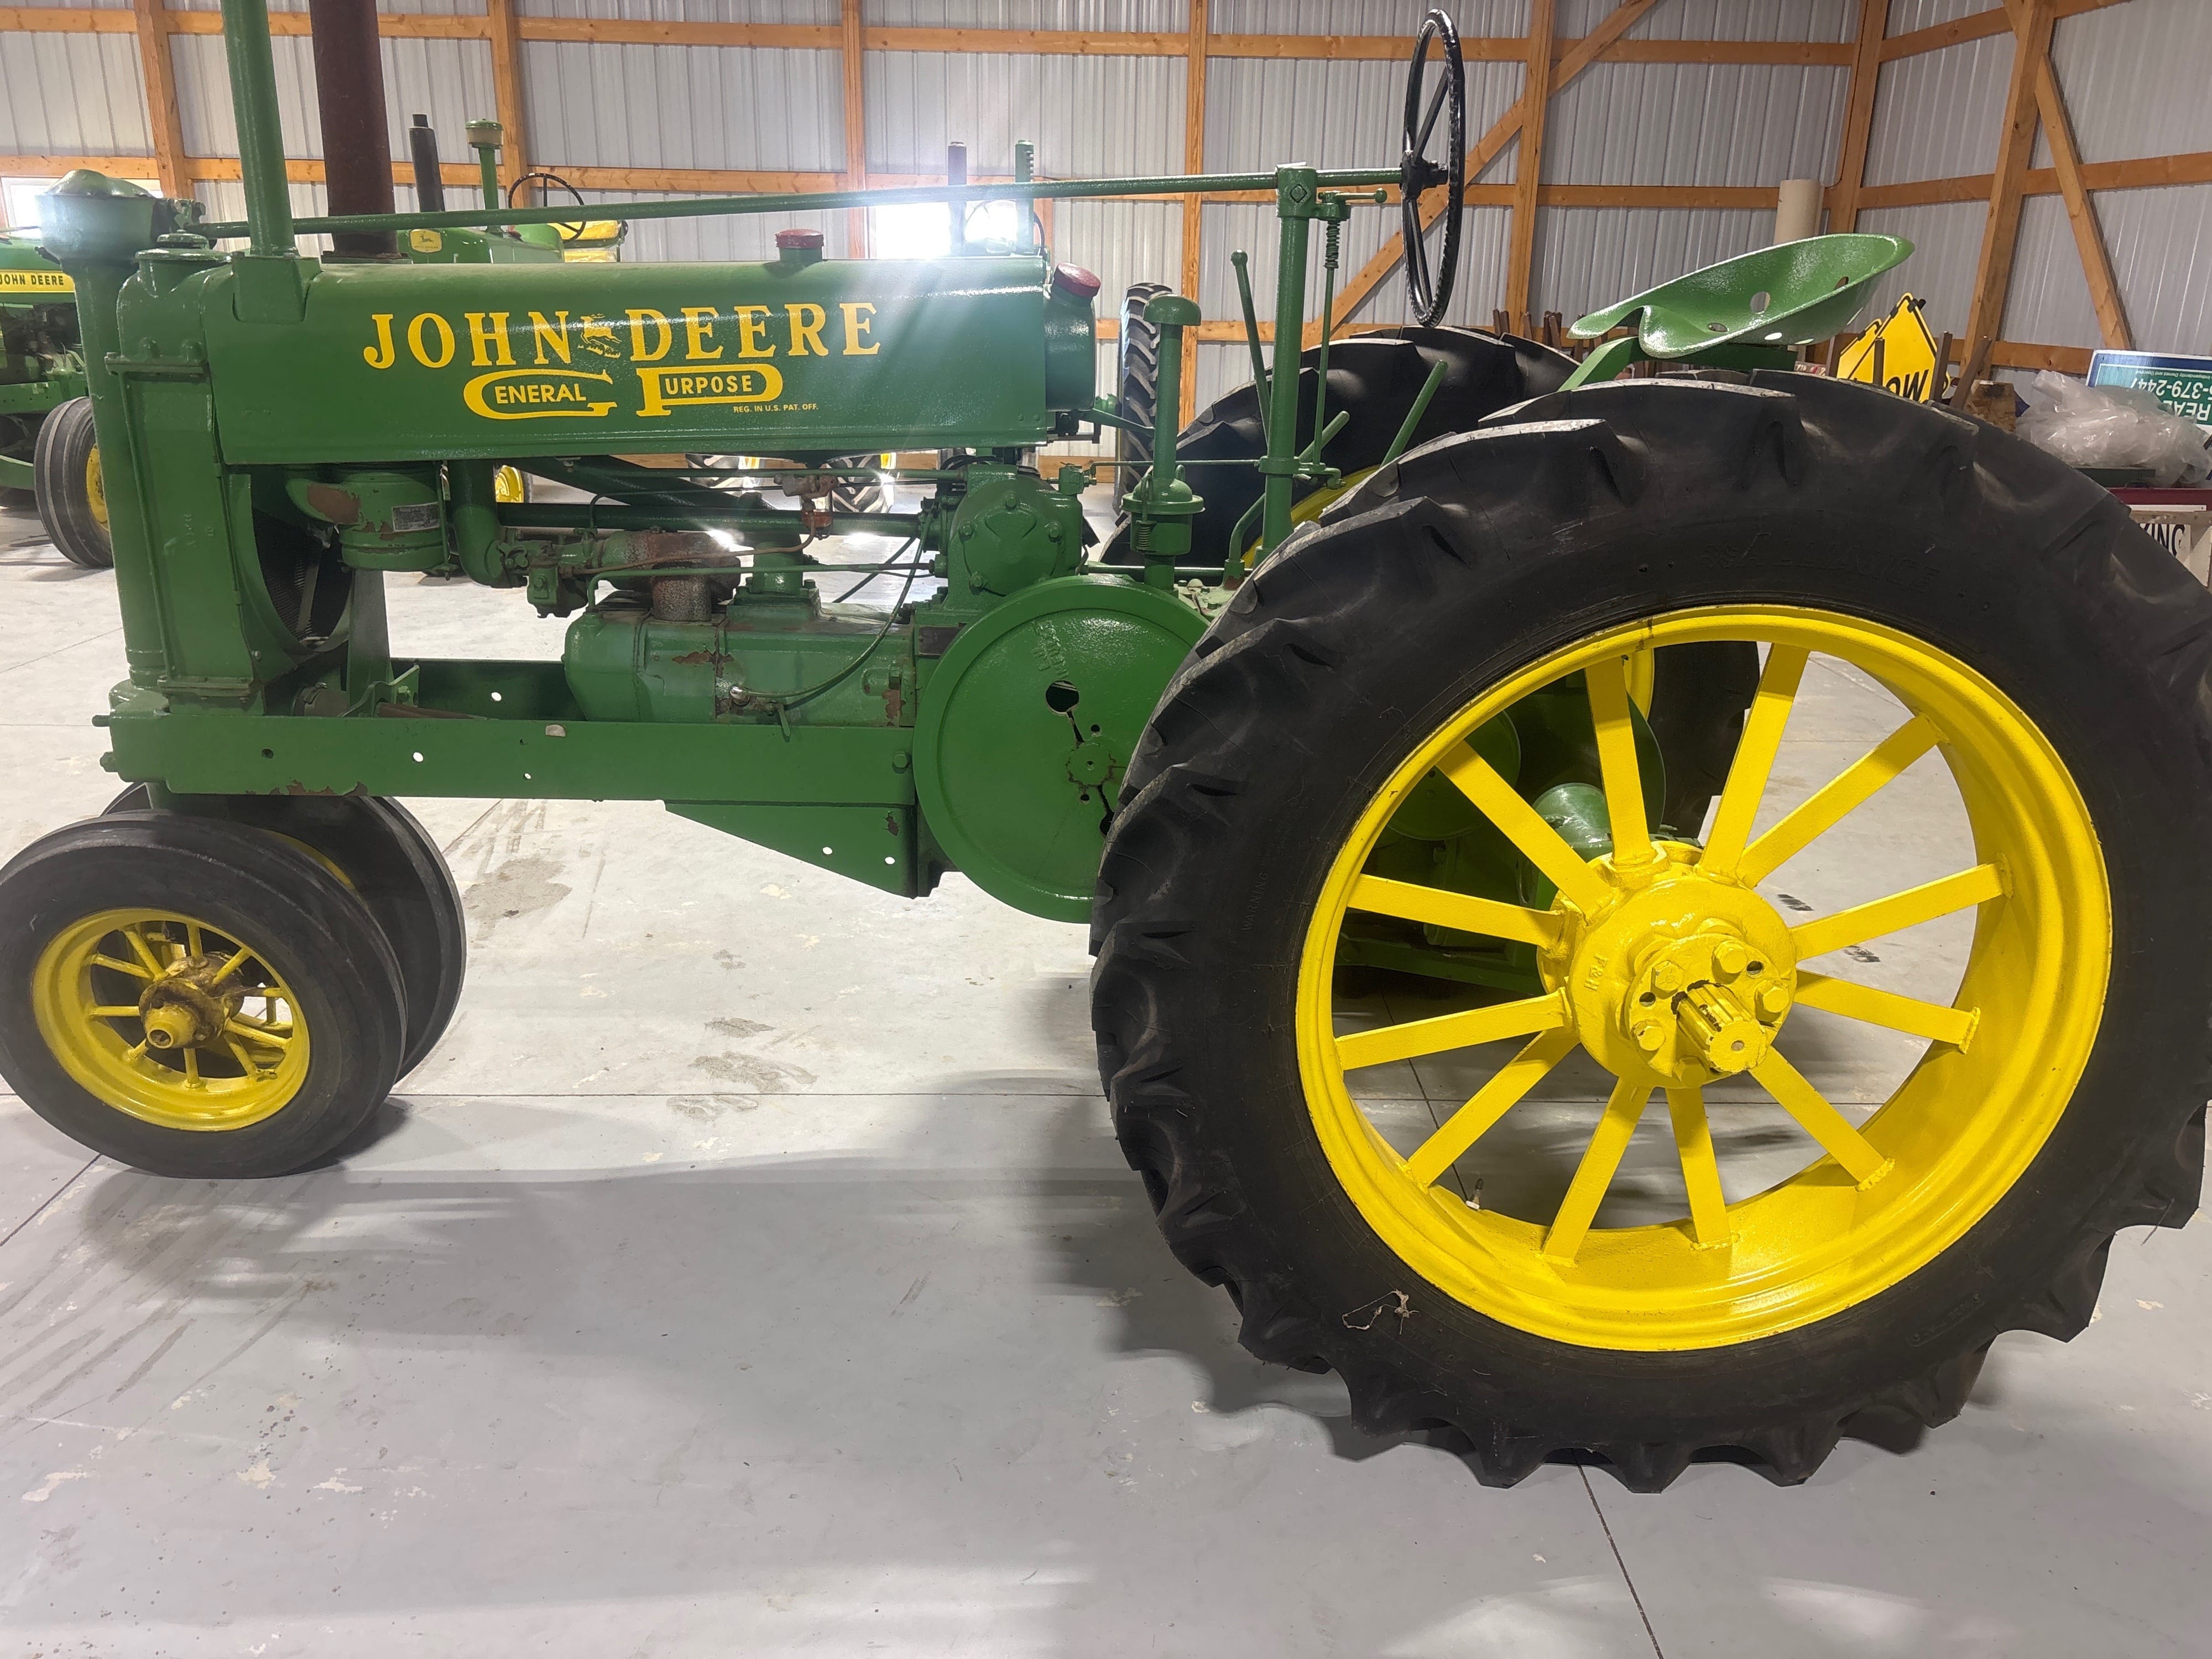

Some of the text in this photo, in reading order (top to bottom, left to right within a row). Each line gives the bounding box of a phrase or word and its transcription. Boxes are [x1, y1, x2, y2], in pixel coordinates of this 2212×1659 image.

[31, 275, 64, 285] DEERE
[363, 302, 881, 369] JOHN DEERE
[1241, 872, 1270, 931] WARNING
